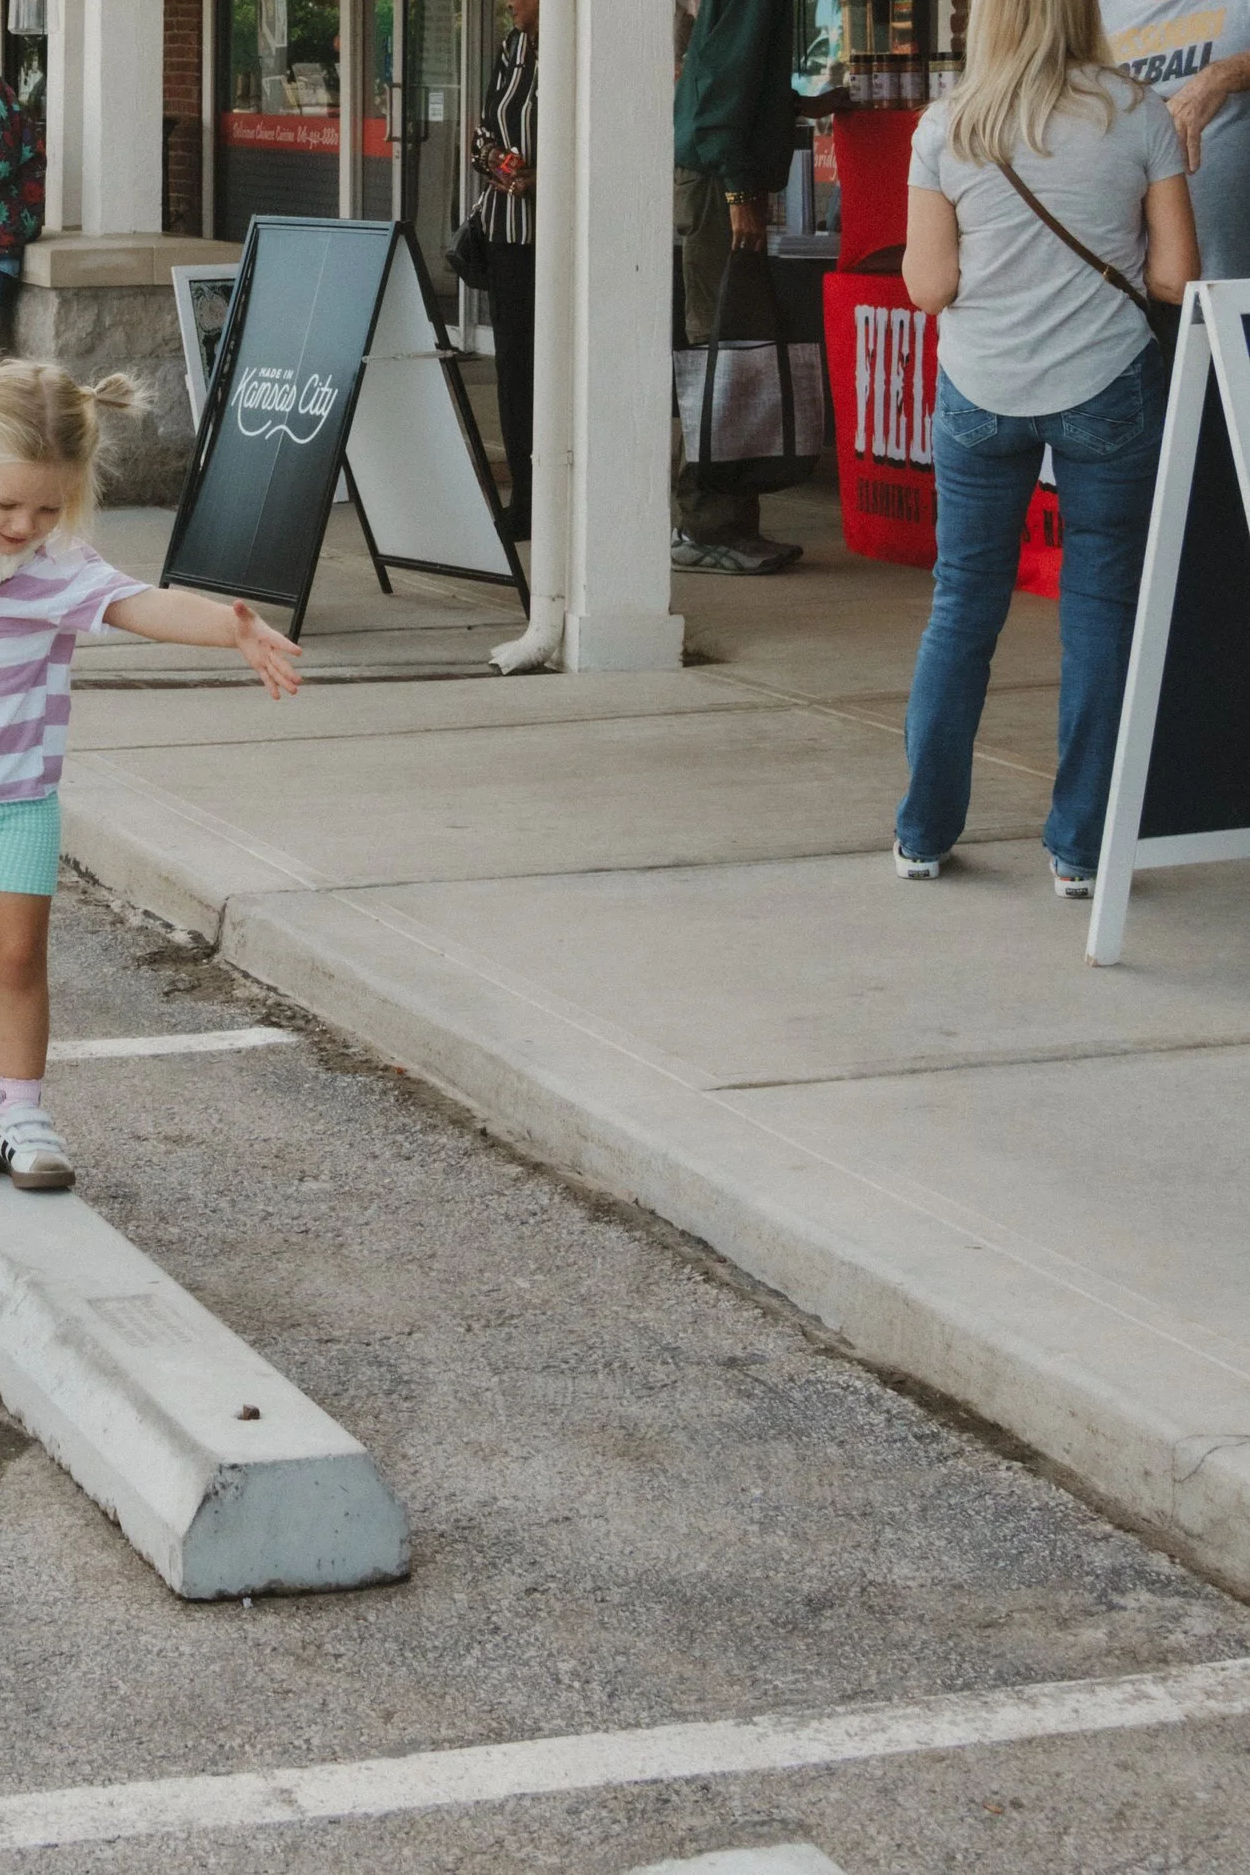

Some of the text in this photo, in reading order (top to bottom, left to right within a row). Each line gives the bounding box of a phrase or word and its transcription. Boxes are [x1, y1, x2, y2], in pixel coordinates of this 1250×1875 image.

[259, 367, 295, 380] MADE IN
[231, 367, 338, 437] Kansas City
